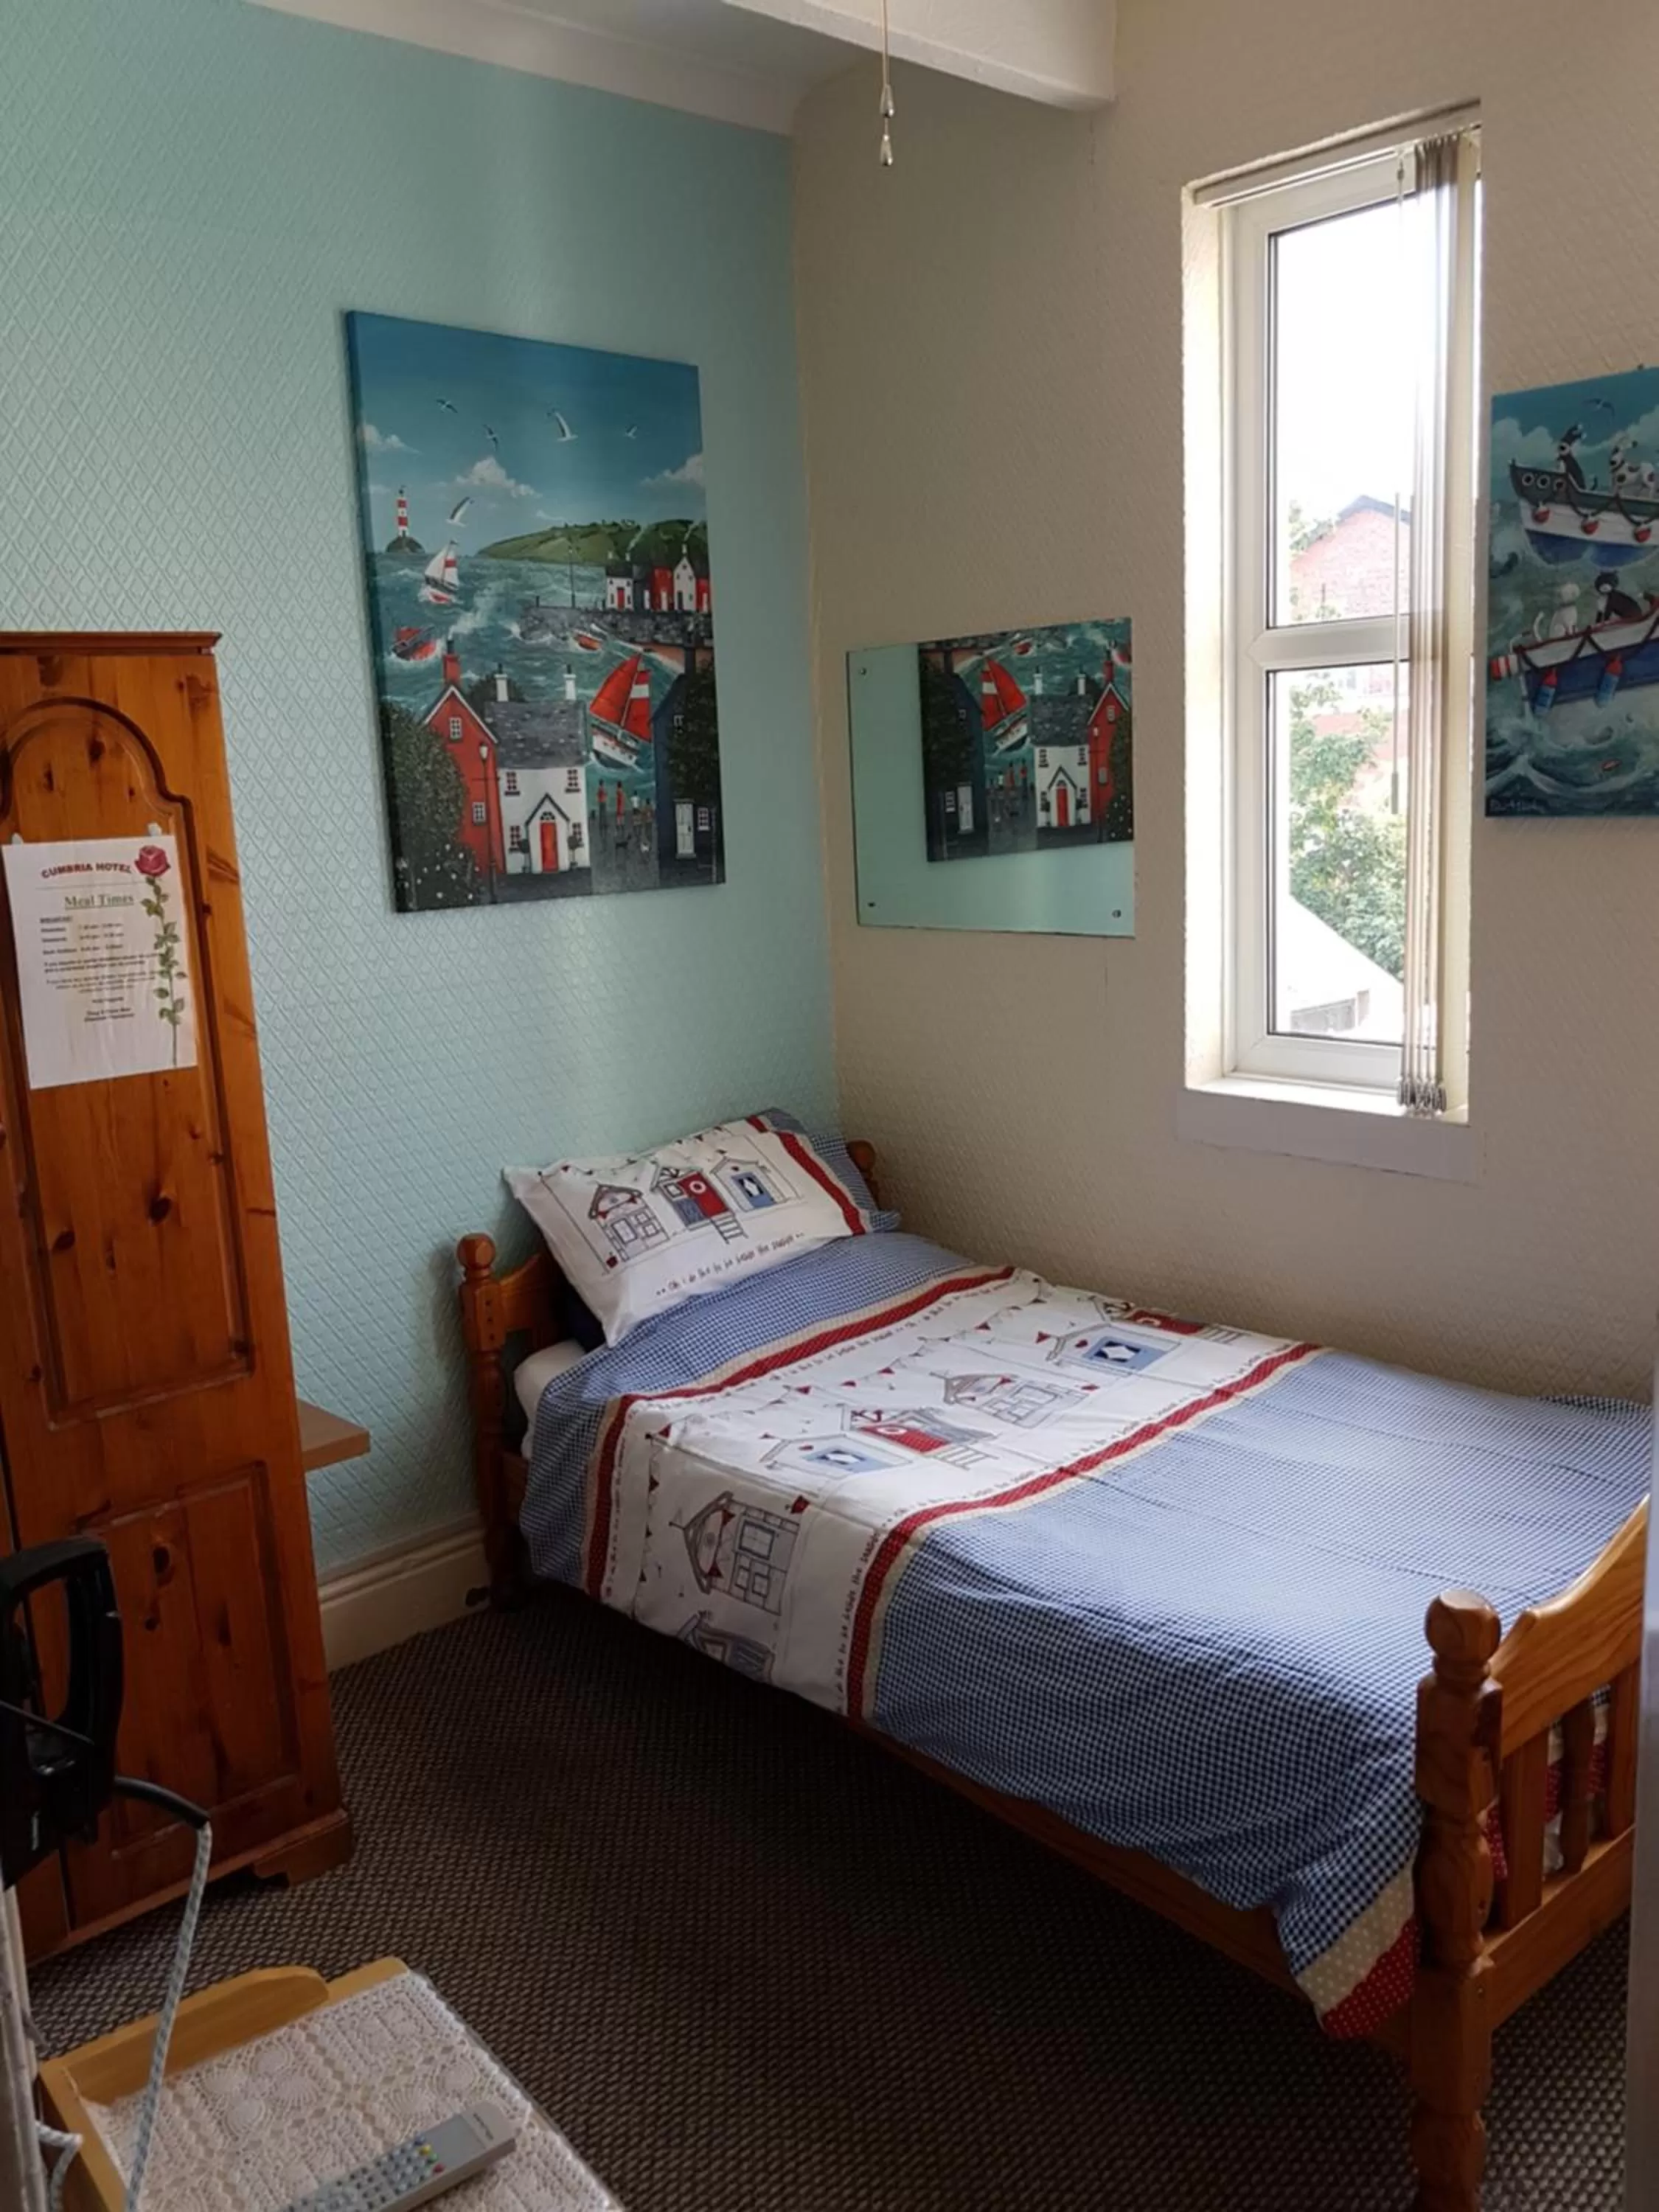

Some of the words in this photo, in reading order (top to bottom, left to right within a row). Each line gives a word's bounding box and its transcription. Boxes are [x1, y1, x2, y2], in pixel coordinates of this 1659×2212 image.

[41, 862, 94, 879] CUMBRIA
[95, 862, 133, 874] HOTEL
[64, 894, 95, 908] Meal
[98, 892, 135, 906] Times
